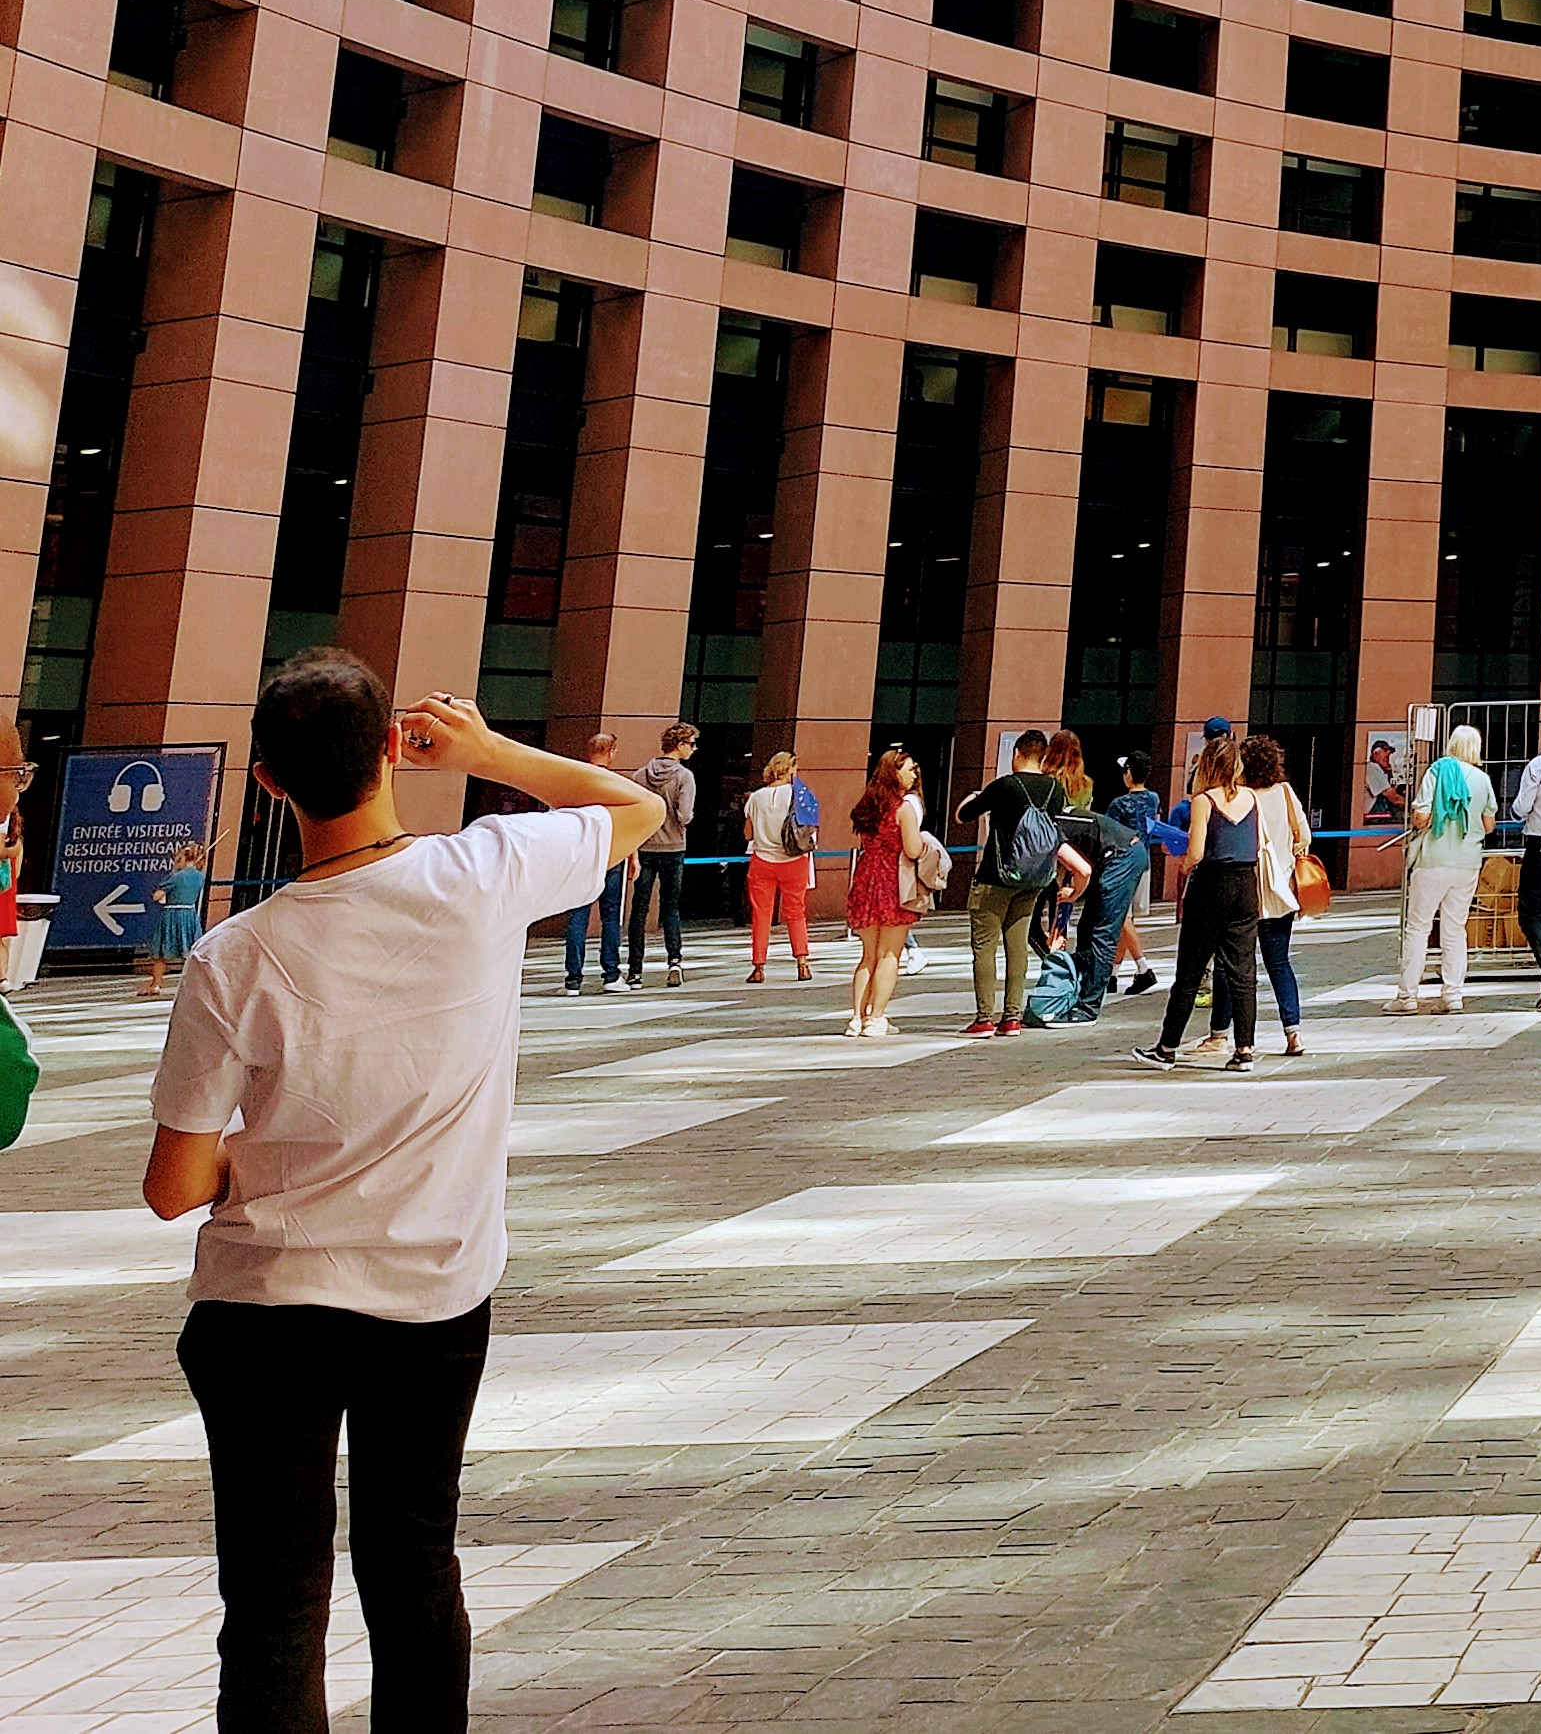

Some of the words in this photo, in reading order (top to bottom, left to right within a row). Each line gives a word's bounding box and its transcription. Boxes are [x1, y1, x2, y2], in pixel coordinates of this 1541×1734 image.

[73, 823, 122, 839] ENTRÉE
[127, 823, 192, 838] VISITEURS
[65, 841, 196, 857] BESUCHEREINGAN
